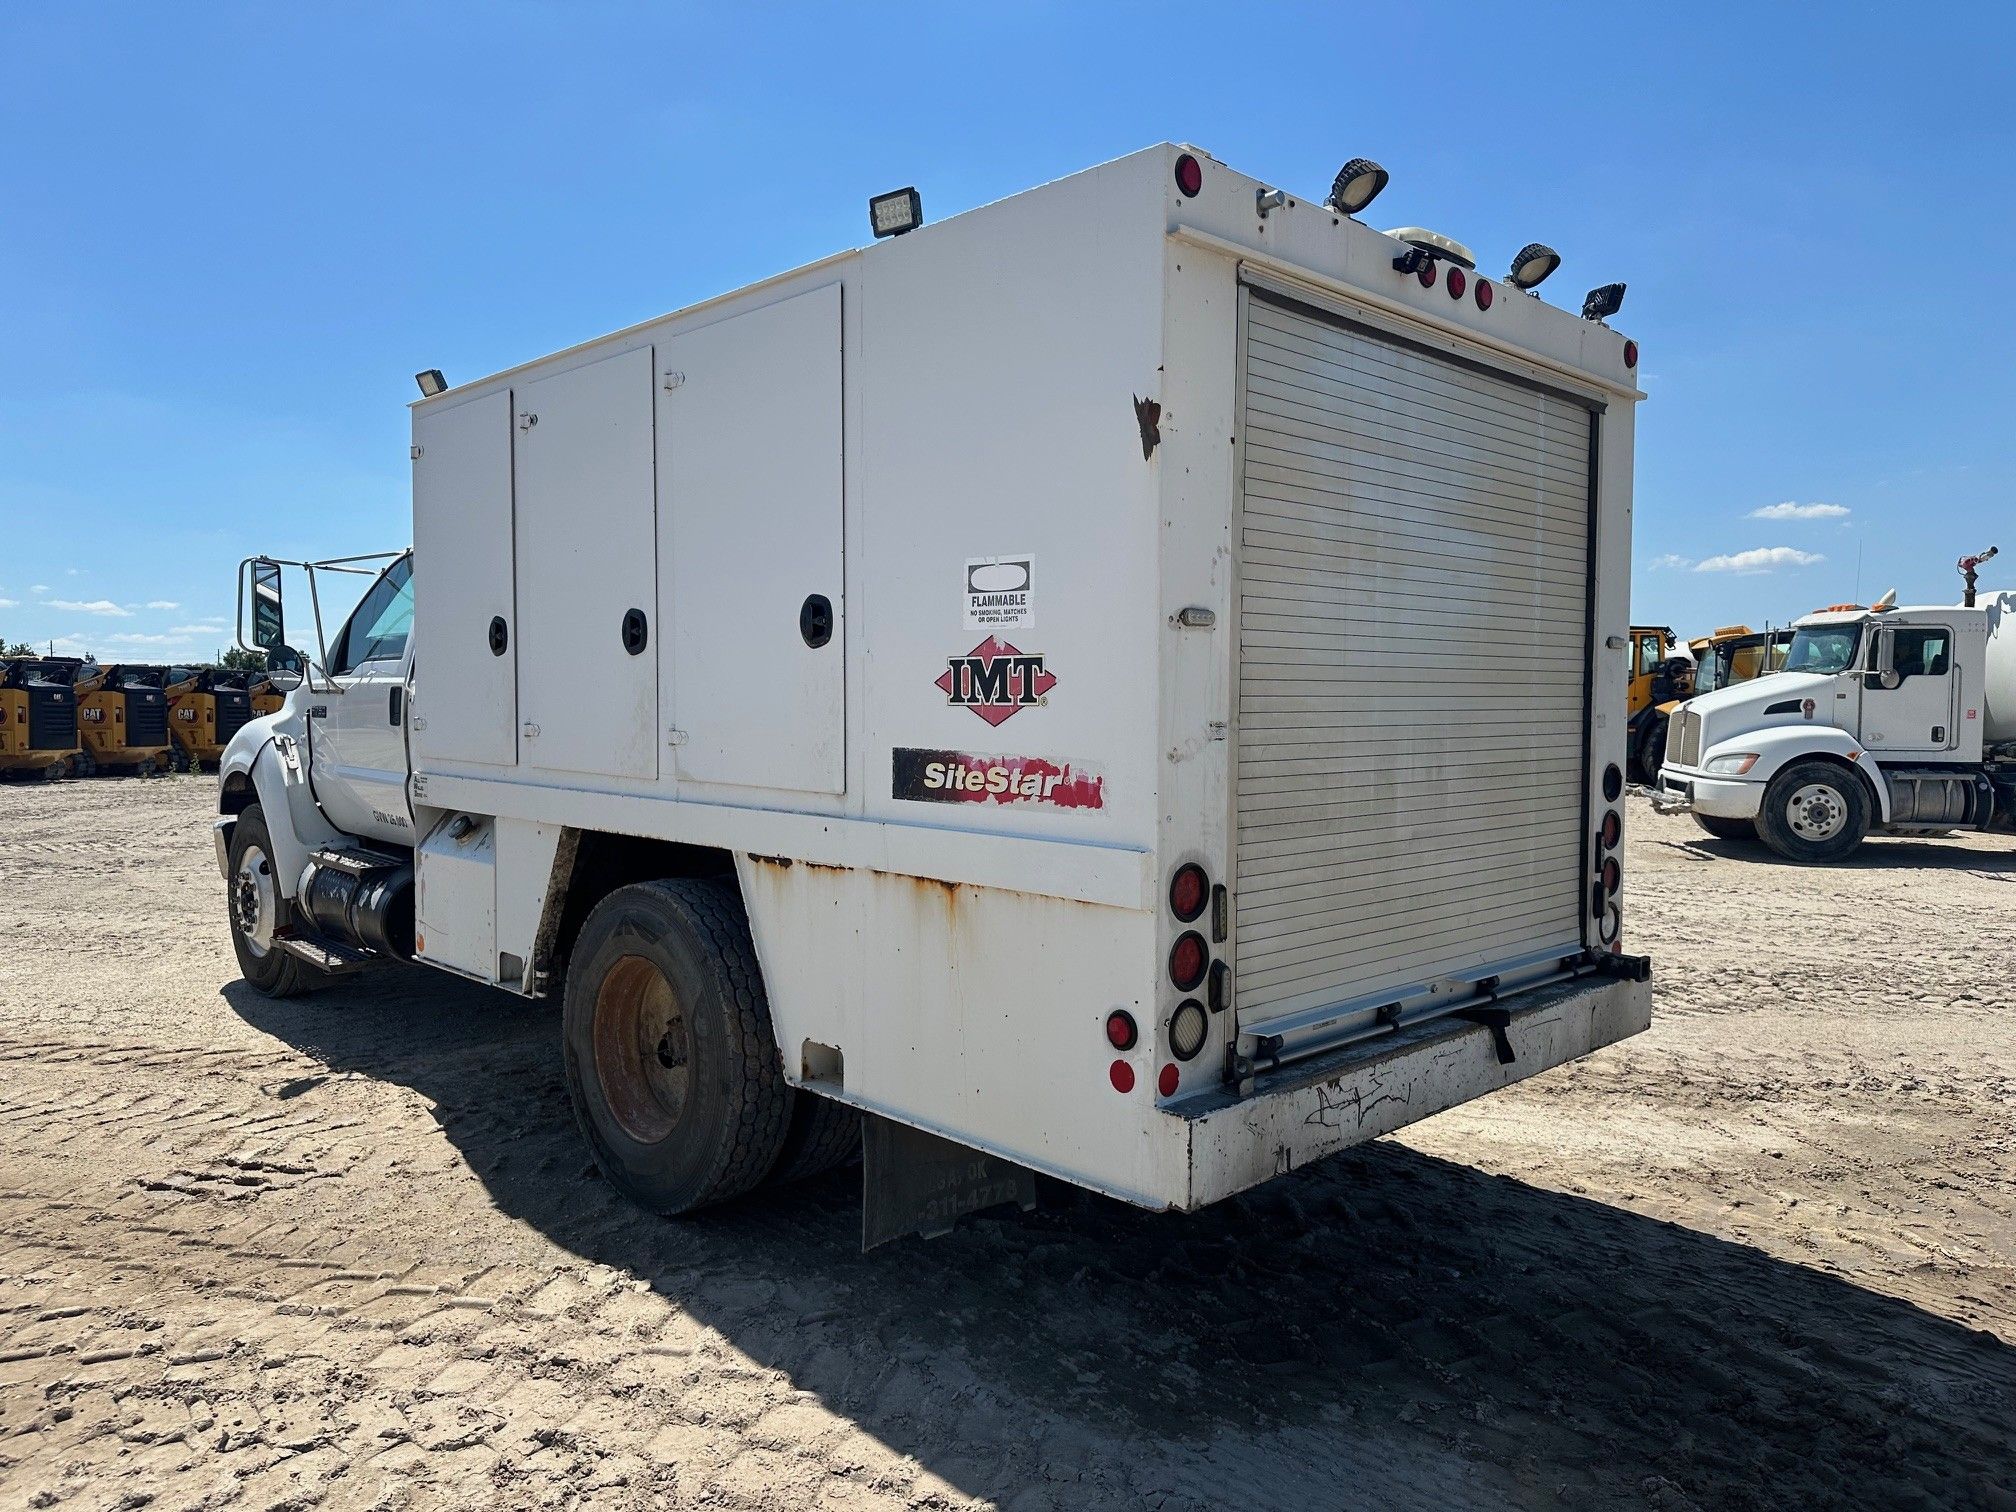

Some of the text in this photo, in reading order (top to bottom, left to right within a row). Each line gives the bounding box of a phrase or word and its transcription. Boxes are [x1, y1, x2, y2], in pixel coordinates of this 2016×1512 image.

[971, 593, 1026, 608] FLAMMABLE
[947, 653, 1045, 707] IMT
[82, 708, 102, 721] CAT
[177, 708, 195, 720] CAT
[923, 762, 1062, 797] SiteStar
[372, 810, 389, 823] GVW
